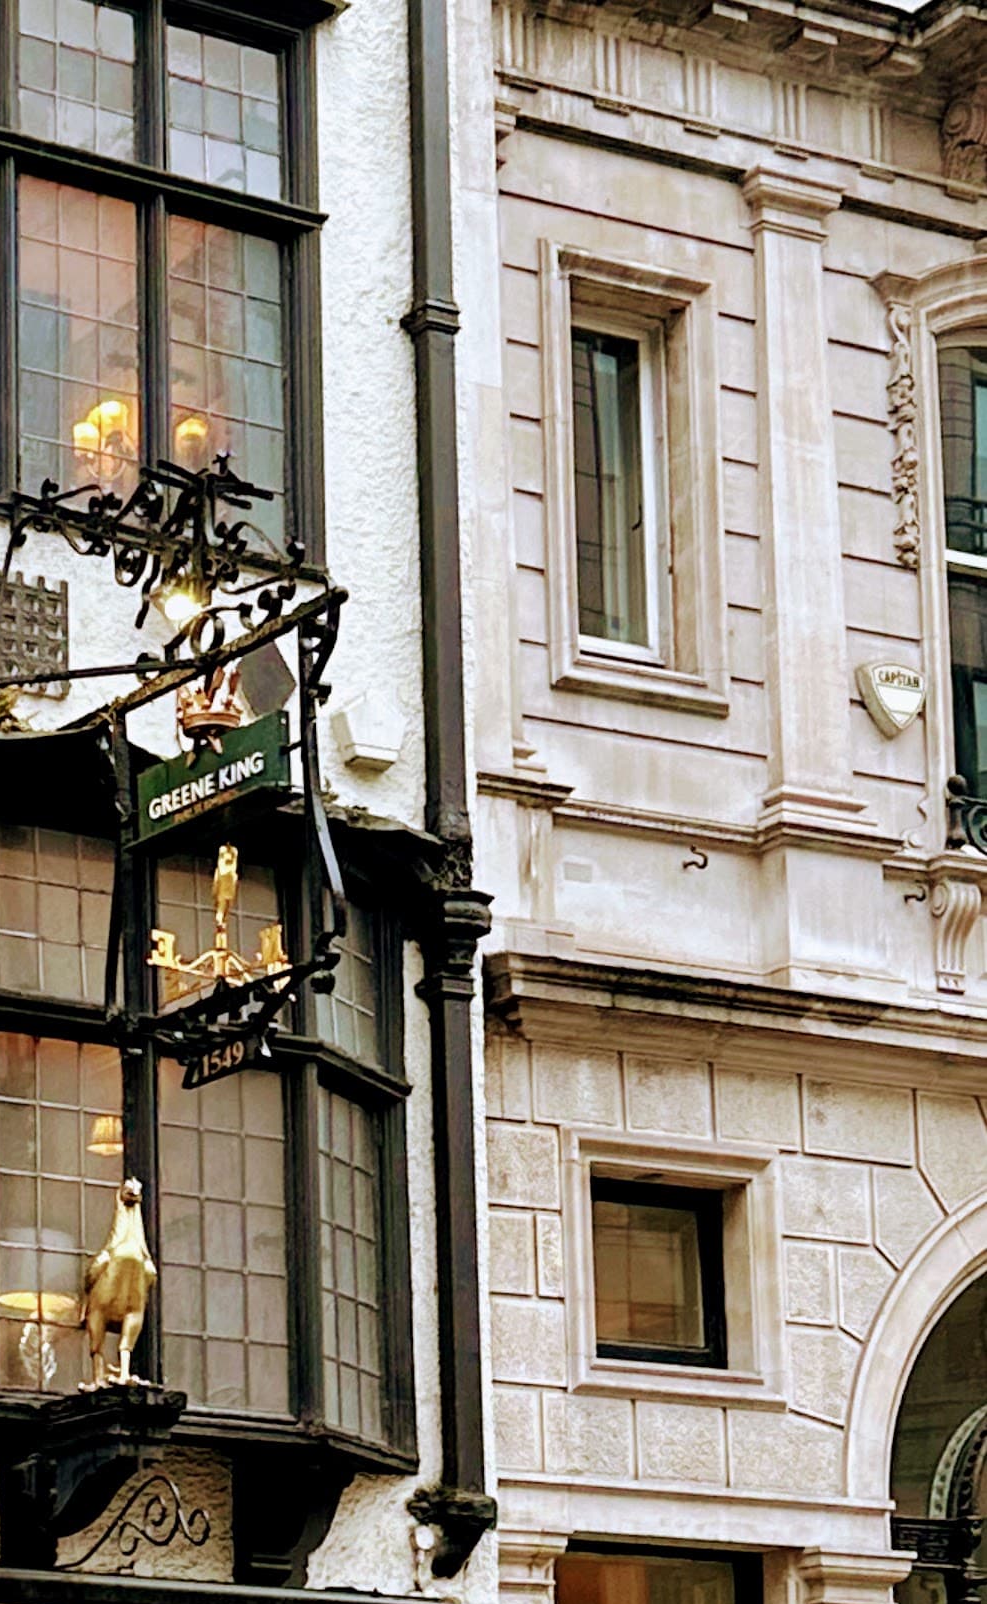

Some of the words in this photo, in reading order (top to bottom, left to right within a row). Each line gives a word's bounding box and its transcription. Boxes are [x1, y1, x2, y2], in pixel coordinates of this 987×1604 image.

[149, 772, 216, 820] GREENE
[218, 752, 264, 790] KING
[202, 1041, 245, 1077] 1549
